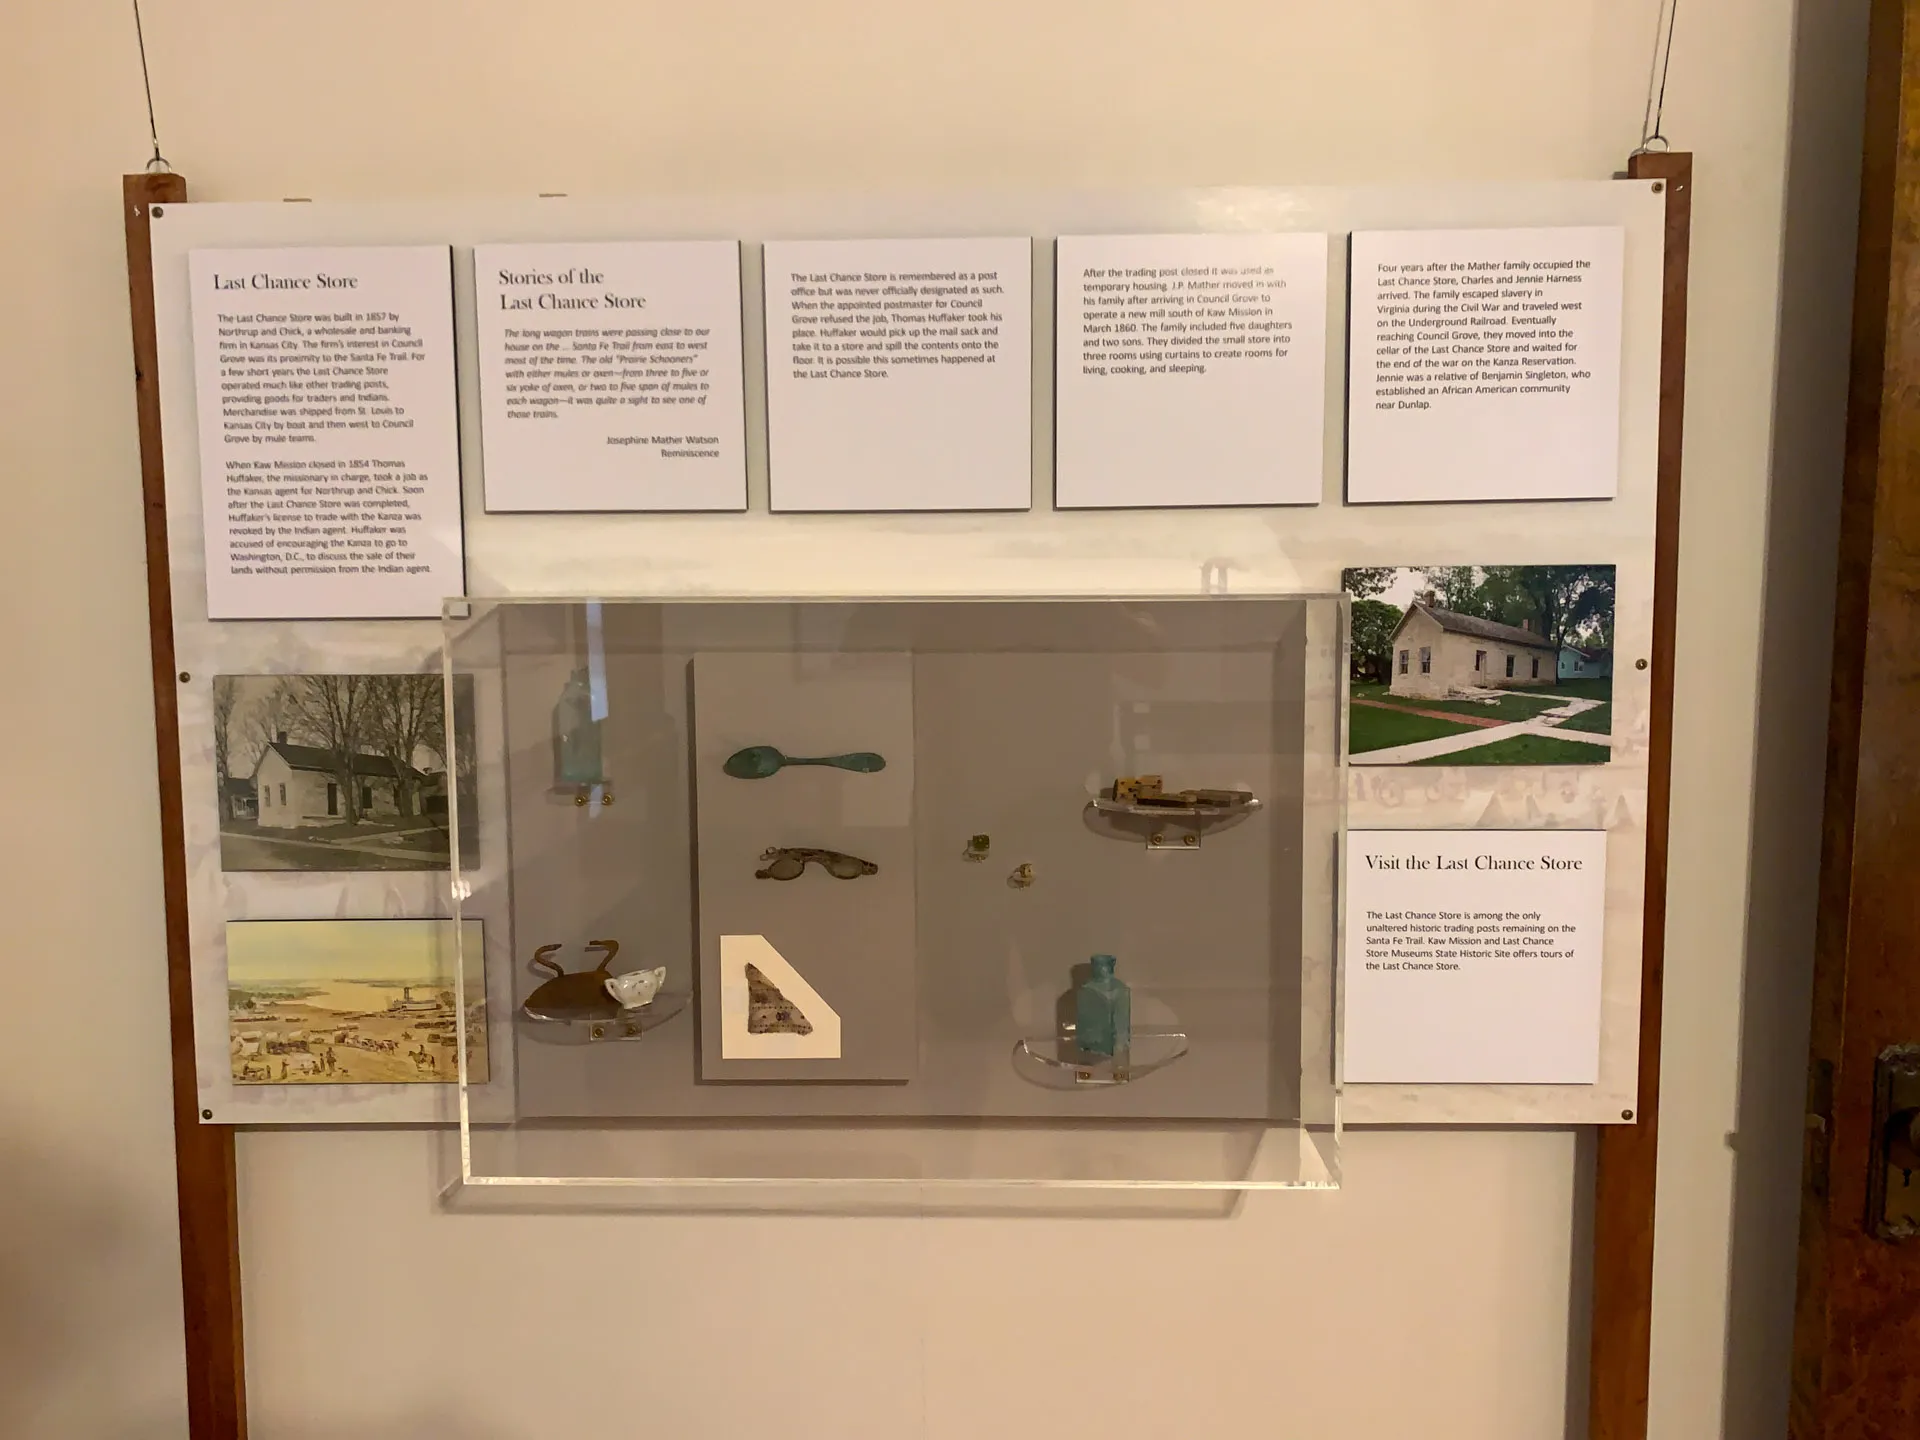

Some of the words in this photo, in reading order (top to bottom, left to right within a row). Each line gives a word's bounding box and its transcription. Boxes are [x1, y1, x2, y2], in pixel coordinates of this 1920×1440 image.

[1377, 263, 1397, 272] Four
[1400, 264, 1424, 274] years
[1426, 261, 1447, 271] after
[1450, 261, 1465, 271] the
[1467, 260, 1501, 271] Mather
[1503, 260, 1530, 271] family
[1532, 259, 1573, 271] occupied
[1575, 259, 1590, 268] the
[213, 273, 245, 290] Last
[251, 273, 311, 289] Chance
[316, 273, 357, 288] Store
[498, 268, 553, 285] Stories
[557, 268, 576, 284] of
[579, 267, 604, 284] the
[1377, 277, 1395, 286] Last
[1397, 276, 1430, 286] Chance
[1432, 275, 1458, 286] Store,
[1460, 274, 1494, 285] Charles
[1495, 274, 1513, 284] and
[1515, 274, 1543, 284] Jennie
[1546, 273, 1582, 283] Harness
[500, 294, 532, 310] Last
[538, 293, 598, 309] Chance
[604, 293, 646, 308] Store
[1376, 304, 1410, 316] Virginia
[1412, 303, 1441, 315] during
[1443, 303, 1458, 312] the
[1460, 302, 1479, 312] Civil
[1481, 302, 1500, 311] War
[1502, 301, 1519, 311] and
[1521, 301, 1558, 311] traveled
[1560, 301, 1582, 310] west
[217, 313, 234, 323] The
[236, 314, 253, 323] Last
[255, 313, 287, 323] Chance
[289, 313, 312, 322] Store
[313, 314, 331, 322] was
[354, 313, 363, 321] in
[791, 314, 818, 324] Grove
[819, 313, 853, 324] refused
[855, 313, 870, 323] the
[890, 312, 926, 323] Thomas
[927, 312, 966, 323] Huffaker
[967, 312, 988, 322] took
[989, 311, 1002, 321] his
[1376, 319, 1388, 327] on
[1391, 318, 1406, 327] the
[1408, 316, 1467, 329] Underground
[1511, 314, 1557, 326] Eventually
[1083, 323, 1112, 333] March
[1140, 322, 1158, 332] The
[1160, 321, 1187, 334] family
[1189, 321, 1227, 331] included
[1229, 320, 1245, 330] five
[1247, 320, 1292, 332] daughters
[1082, 337, 1100, 347] and
[1102, 337, 1120, 347] two
[1121, 338, 1144, 346] sons.
[1146, 336, 1168, 348] They
[1170, 335, 1203, 345] divided
[1204, 335, 1220, 344] the
[1222, 334, 1245, 344] small
[1247, 335, 1271, 344] store
[1273, 334, 1291, 343] into
[1376, 359, 1391, 368] the
[1393, 359, 1411, 368] end
[1412, 358, 1422, 368] of
[1424, 358, 1440, 368] the
[1441, 359, 1459, 367] war
[1460, 359, 1473, 367] on
[1475, 357, 1490, 367] the
[1492, 357, 1519, 366] Kanza
[1521, 356, 1576, 366] Reservation.
[792, 368, 808, 378] the
[809, 369, 828, 378] Last
[829, 368, 862, 378] Chance
[863, 368, 889, 378] Store.
[1082, 364, 1108, 376] living,
[1110, 364, 1147, 375] cooking,
[1149, 364, 1166, 373] and
[1376, 373, 1404, 382] Jennie
[1406, 374, 1424, 382] was
[1433, 371, 1467, 381] relative
[1469, 370, 1479, 380] of
[1481, 370, 1523, 382] Benjamin
[1524, 369, 1568, 381] Singleton,
[1570, 369, 1591, 379] who
[1375, 385, 1425, 396] established
[1427, 387, 1439, 395] an
[1441, 384, 1472, 395] African
[1474, 384, 1517, 394] American
[1519, 384, 1570, 394] community
[1397, 399, 1431, 410] Dunlap.
[223, 433, 250, 444] Grove
[606, 435, 649, 446] Josephine
[651, 435, 683, 444] Mather
[685, 435, 719, 444] Watson
[660, 448, 720, 458] Reminiscence
[1365, 855, 1400, 869] Visit
[1406, 854, 1430, 869] the
[1436, 855, 1468, 869] Last
[1474, 855, 1535, 870] Chance
[1540, 855, 1582, 870] Store
[1366, 910, 1383, 919] The
[1385, 911, 1403, 919] Last
[1404, 910, 1437, 919] Chance
[1438, 911, 1461, 920] Store
[1463, 911, 1471, 919] is
[1472, 912, 1503, 921] among
[1505, 911, 1520, 920] the
[1521, 911, 1541, 921] only
[1366, 923, 1408, 932] unaltered
[1409, 923, 1441, 932] historic
[1443, 923, 1474, 934] trading
[1476, 924, 1500, 934] posts
[1502, 924, 1545, 934] remaining
[1561, 923, 1576, 932] the
[1366, 936, 1390, 944] Santa
[1392, 936, 1403, 945] Fe
[1405, 936, 1425, 945] Trail.
[1427, 936, 1446, 945] Kaw
[1448, 936, 1481, 945] Mission
[1483, 936, 1500, 945] and
[1502, 937, 1520, 945] Last
[1522, 936, 1554, 945] Chance
[1365, 948, 1388, 957] Store
[1391, 949, 1433, 958] Museums
[1435, 949, 1457, 958] State
[1459, 949, 1492, 958] Historic
[1494, 949, 1510, 958] Site
[1512, 949, 1538, 958] offers
[1540, 950, 1563, 958] tours
[1564, 949, 1574, 958] of
[1365, 961, 1380, 970] the
[1382, 962, 1400, 970] Last
[1401, 961, 1433, 970] Chance
[1435, 961, 1460, 970] Store.
